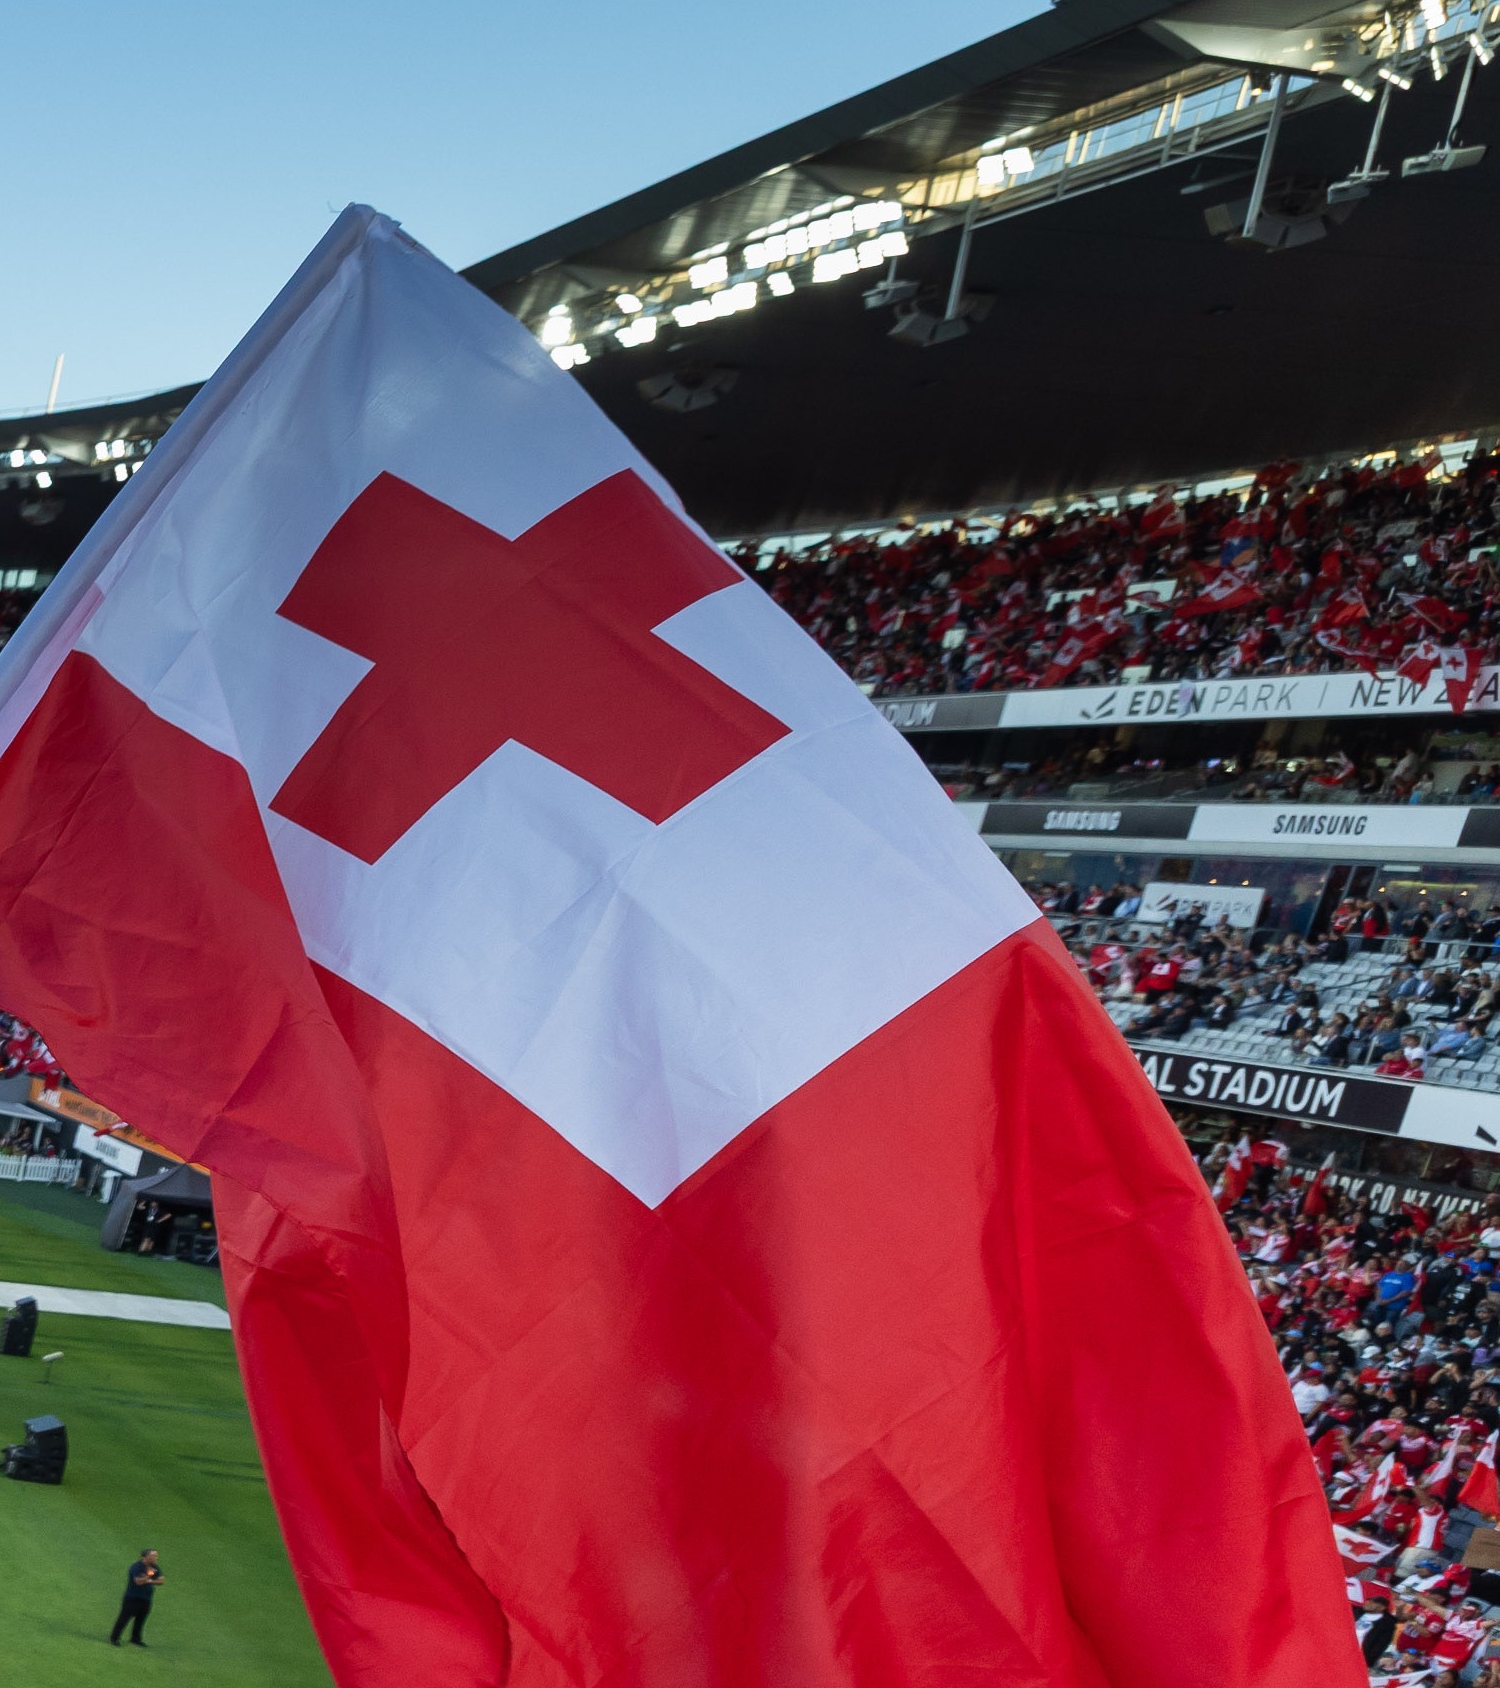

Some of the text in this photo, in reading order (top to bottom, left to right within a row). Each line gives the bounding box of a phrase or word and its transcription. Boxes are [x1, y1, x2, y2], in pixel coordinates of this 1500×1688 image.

[1210, 681, 1301, 713] PARK
[1350, 676, 1425, 709] NEW
[1045, 811, 1121, 831] SAMSUNG
[1273, 815, 1367, 836] SAMSUNG
[1183, 1061, 1347, 1118] STADIUM
